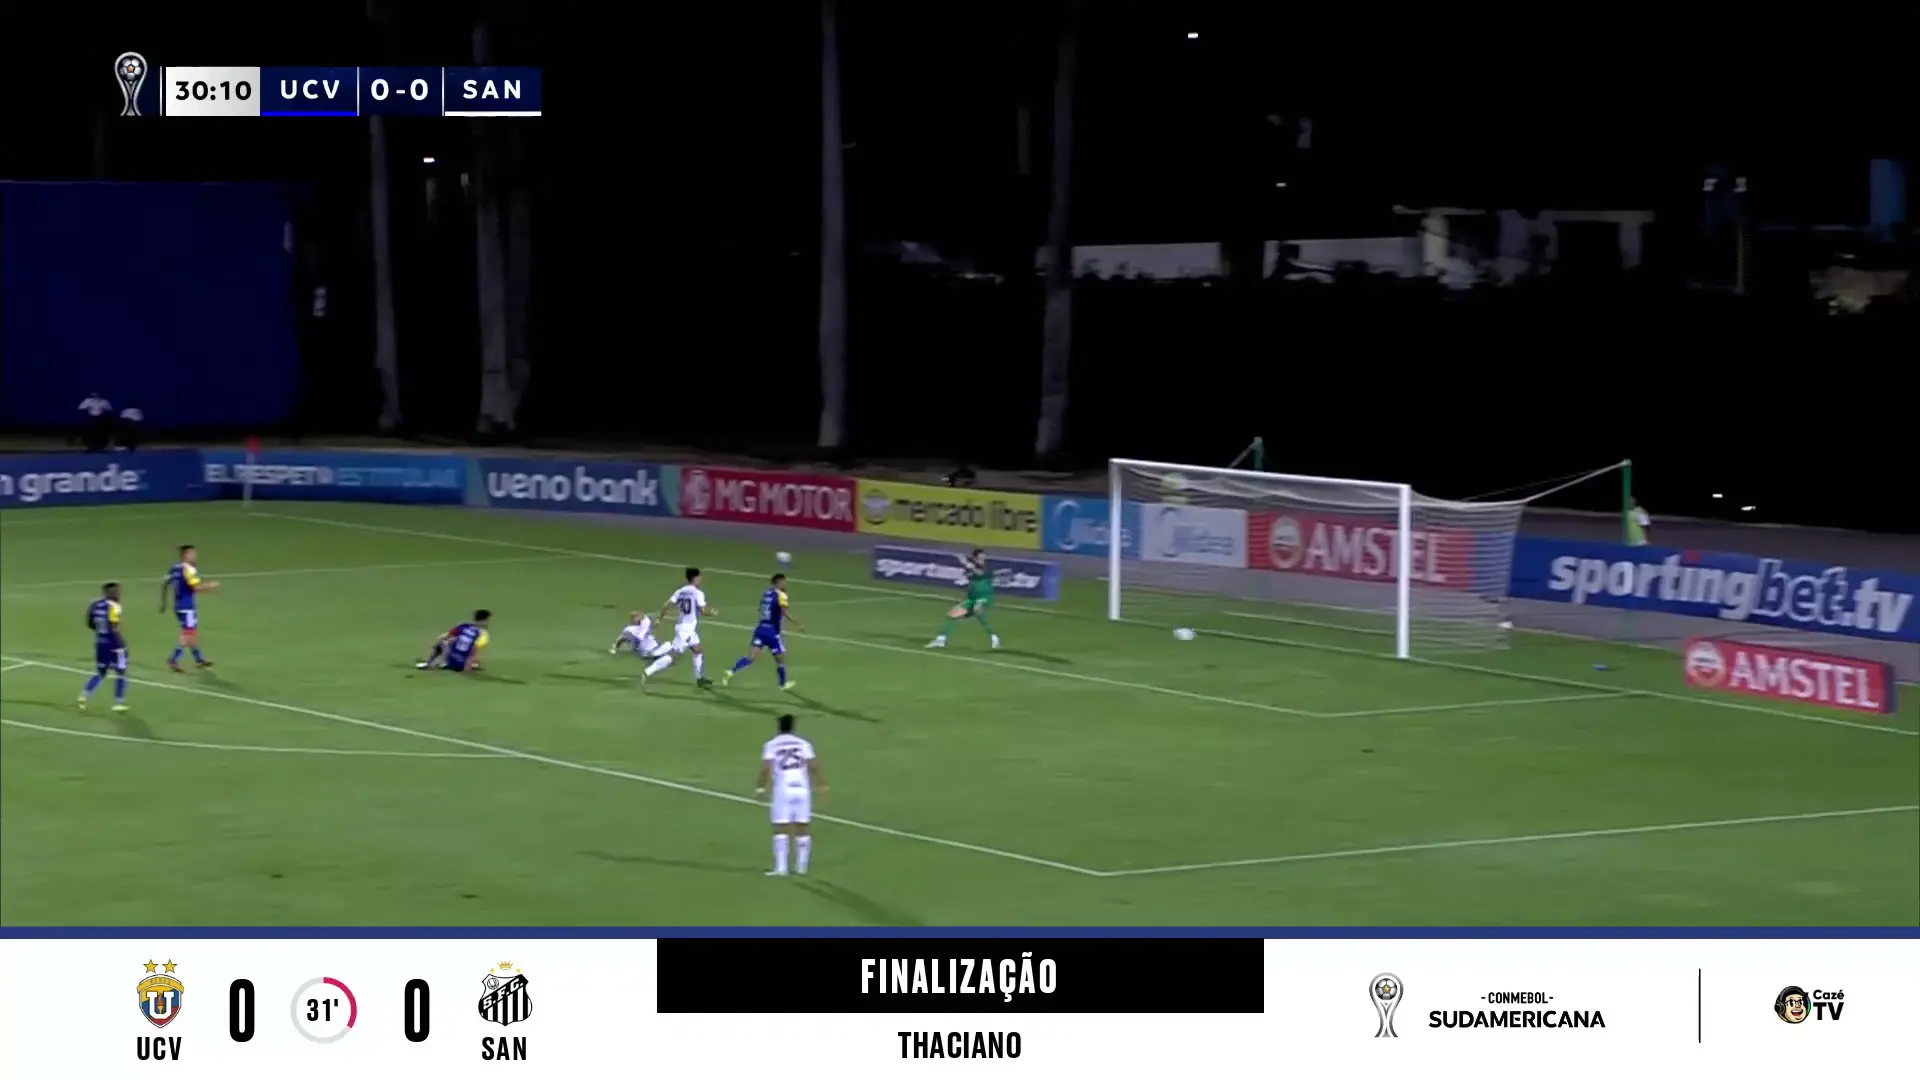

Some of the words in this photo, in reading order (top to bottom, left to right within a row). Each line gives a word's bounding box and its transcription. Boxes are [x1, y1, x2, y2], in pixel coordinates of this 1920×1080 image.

[19, 463, 140, 502] grande
[488, 472, 571, 501] ueno
[574, 466, 658, 506] bank
[713, 478, 757, 514] MG
[758, 481, 852, 521] MOTOR
[1548, 555, 1912, 633] sportingbet.tv
[1728, 651, 1880, 709] AMSTEL
